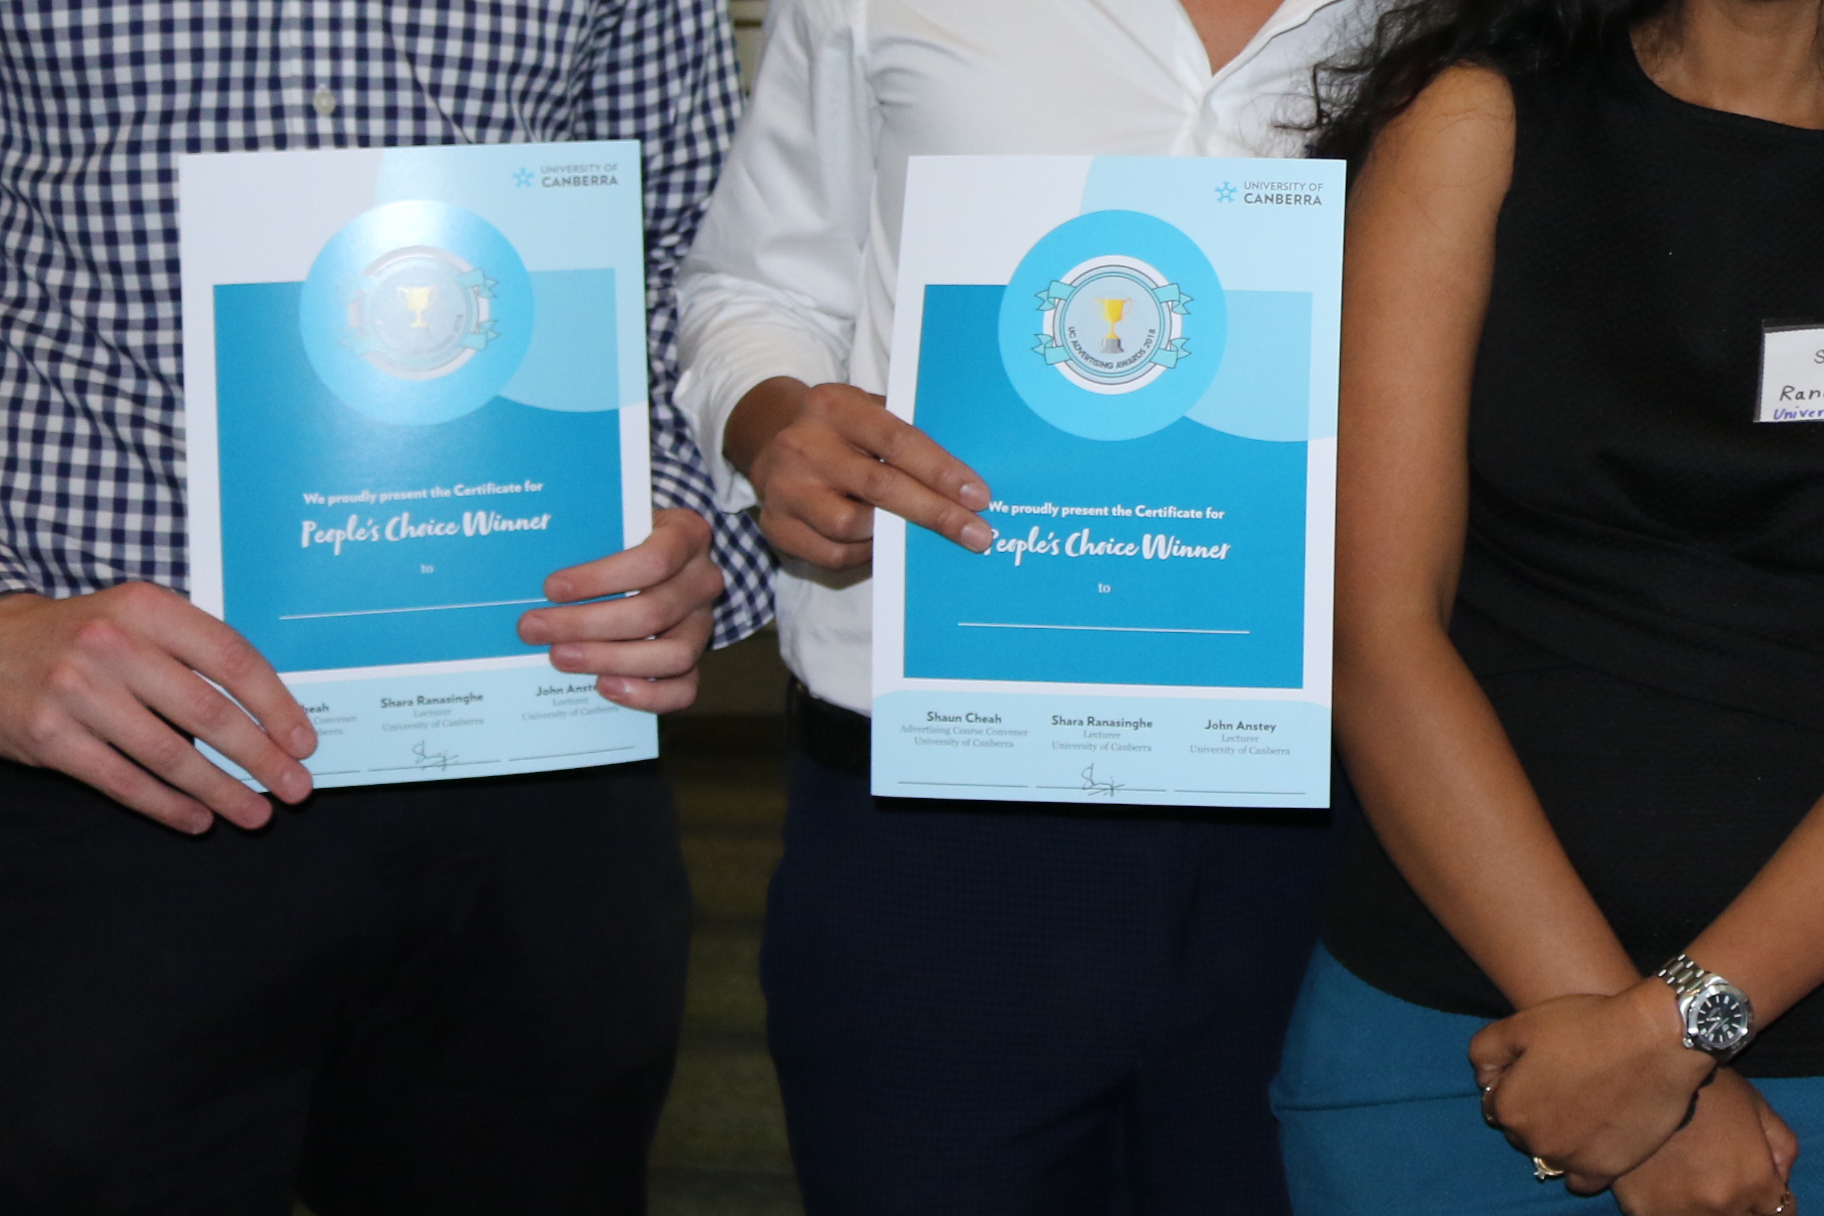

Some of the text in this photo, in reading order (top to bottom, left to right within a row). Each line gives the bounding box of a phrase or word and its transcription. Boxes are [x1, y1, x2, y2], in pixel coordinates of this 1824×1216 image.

[541, 163, 618, 174] UNIVERSITY OF
[541, 175, 618, 188] CANBERRA
[1244, 181, 1324, 192] UNIVERSITY OF
[1244, 192, 1322, 206] CANBERRA
[1071, 340, 1114, 370] ADVERTISING
[1115, 348, 1146, 369] AWARDS
[1143, 329, 1156, 349] 2018
[303, 479, 544, 507] We proudly present the Certificate for
[988, 500, 1225, 520] We proudly present the Certificate for
[301, 510, 552, 556] People's Choice Winner
[1064, 527, 1140, 557] Choice
[1141, 533, 1232, 560] Winner
[420, 563, 434, 574] to
[1098, 583, 1111, 593] to
[535, 685, 564, 697] John
[381, 692, 484, 709] Shara Ranasinghe
[926, 711, 1002, 724] Shaun Cheah
[1051, 715, 1153, 731] Shara Ranasinghe
[900, 725, 950, 736] Advertising
[952, 726, 983, 735] Course
[1205, 719, 1277, 734] John Anstey
[1083, 730, 1121, 739] Lecturer
[1221, 734, 1259, 743] Lecturer
[914, 737, 1014, 749] University of Canberra
[1051, 741, 1152, 752] University of Canberra
[1189, 745, 1291, 756] University of Canberra
